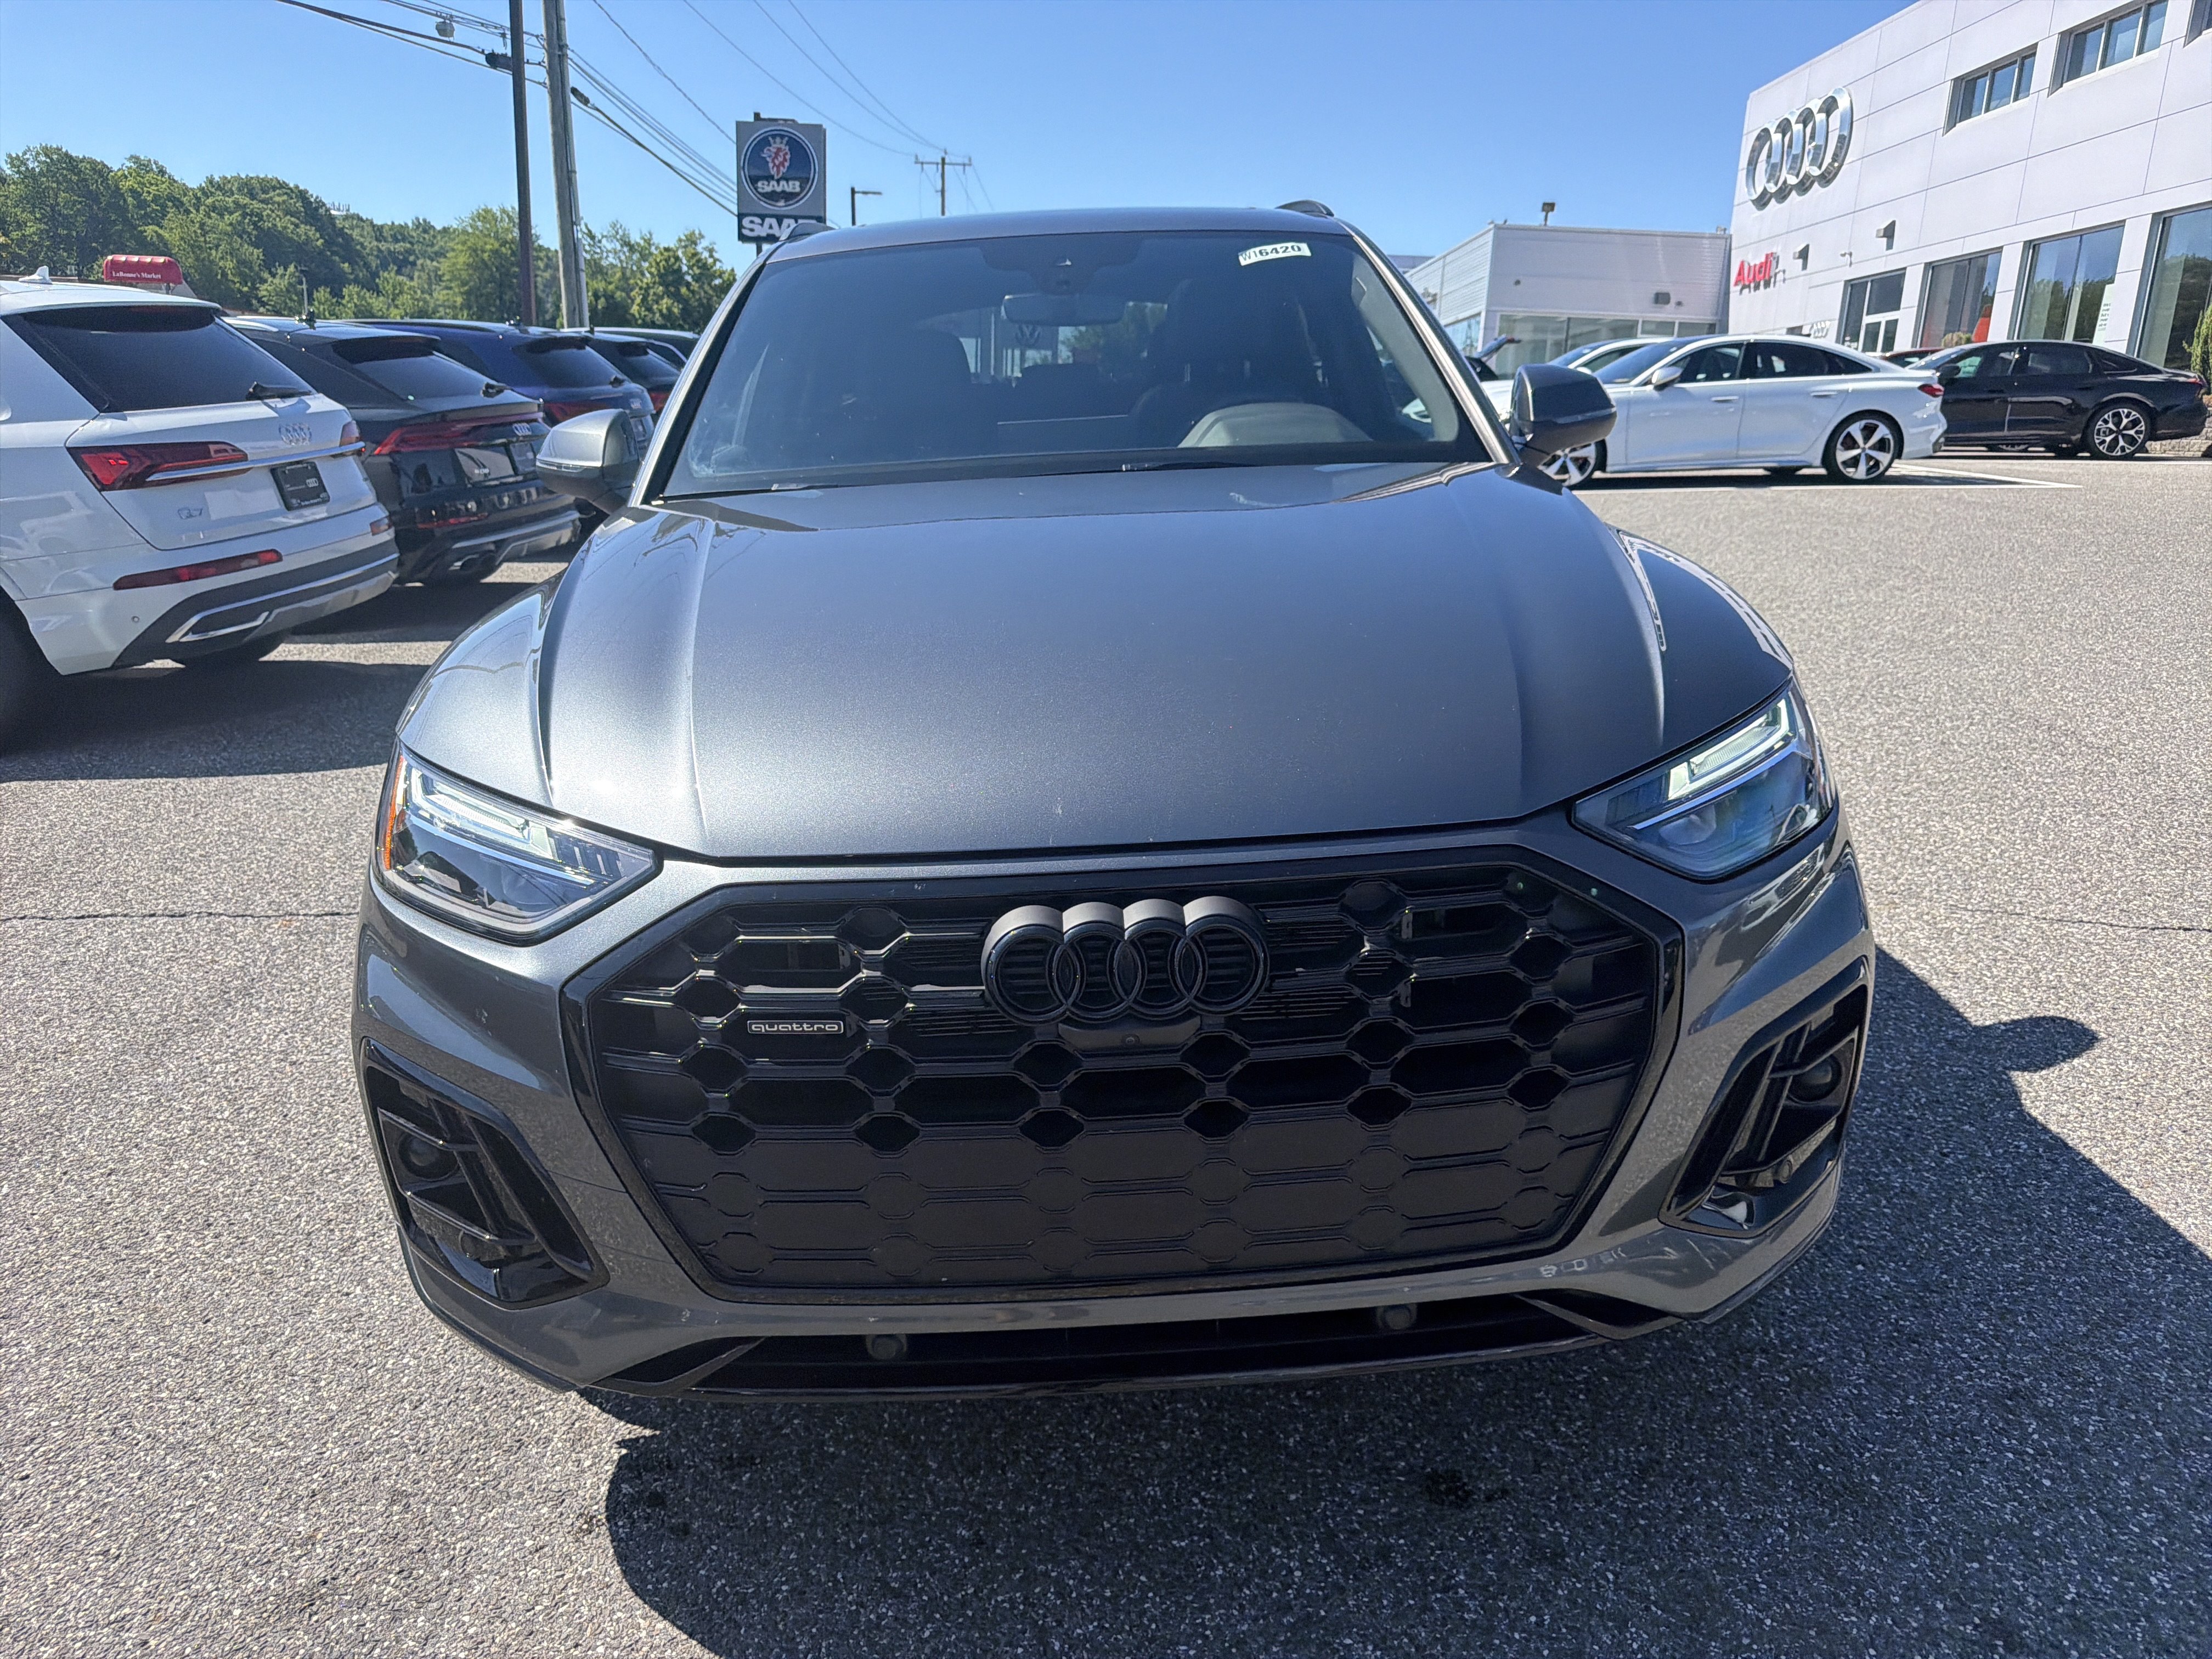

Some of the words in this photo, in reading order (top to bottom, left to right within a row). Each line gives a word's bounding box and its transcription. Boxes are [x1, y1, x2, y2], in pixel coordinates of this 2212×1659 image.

[757, 180, 800, 192] SAAB
[741, 216, 817, 237] SAA
[1733, 252, 1774, 287] Audi
[752, 1023, 838, 1032] quattro
